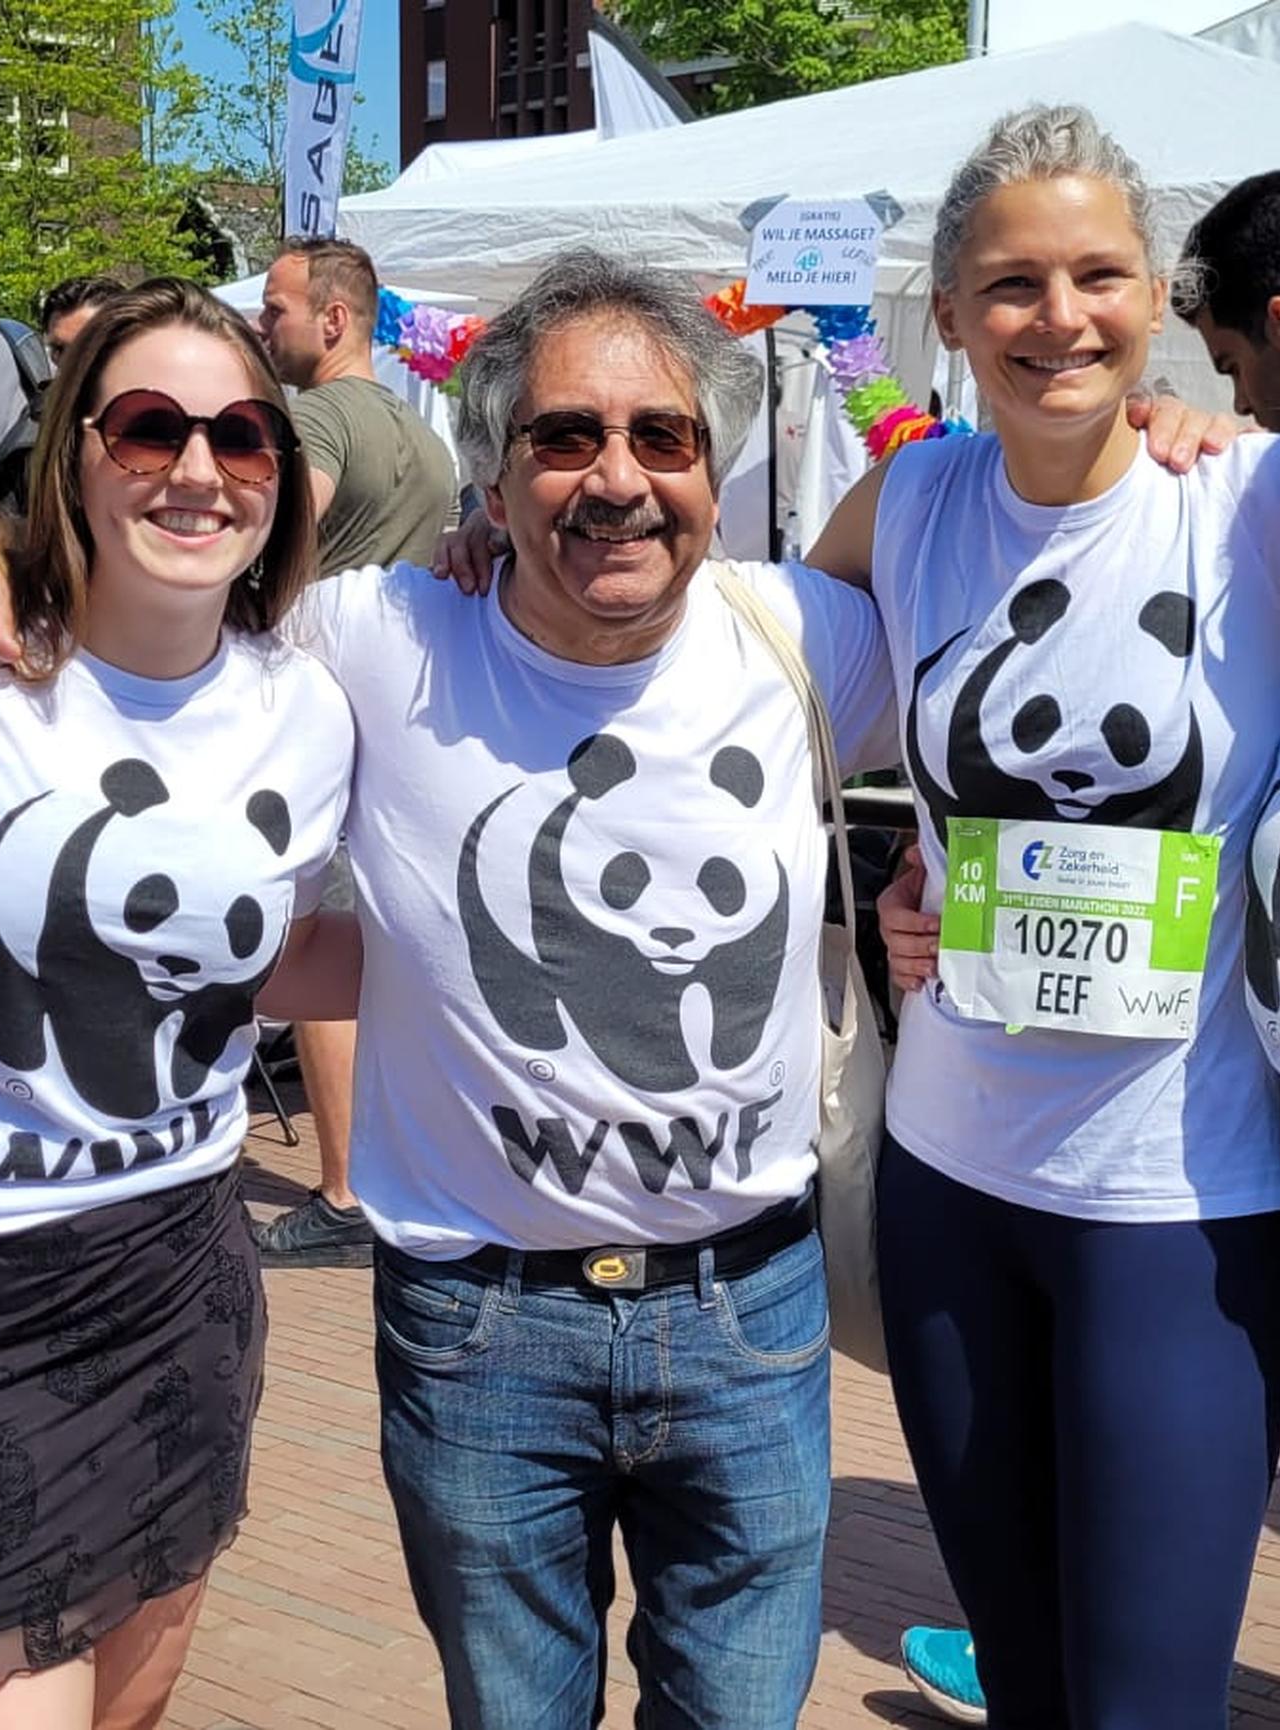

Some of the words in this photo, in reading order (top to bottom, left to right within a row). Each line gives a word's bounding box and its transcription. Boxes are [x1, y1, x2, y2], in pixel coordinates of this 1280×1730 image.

[300, 0, 344, 236] SAGE
[762, 228, 784, 240] WIL
[788, 228, 802, 240] JE
[805, 227, 875, 240] MASSAGE?
[767, 271, 803, 284] MELD
[805, 272, 820, 284] JE
[822, 272, 856, 284] HIER!
[1059, 848, 1087, 861] Zorg
[1090, 850, 1105, 861] en
[959, 861, 983, 880] 10
[1058, 860, 1120, 876] Zekerheid
[954, 884, 986, 904] KM
[1175, 877, 1200, 918] F
[1014, 913, 1129, 963] 10270
[1035, 971, 1092, 1015] EEF
[1118, 986, 1192, 1015] WWF
[491, 1089, 783, 1195] WWF
